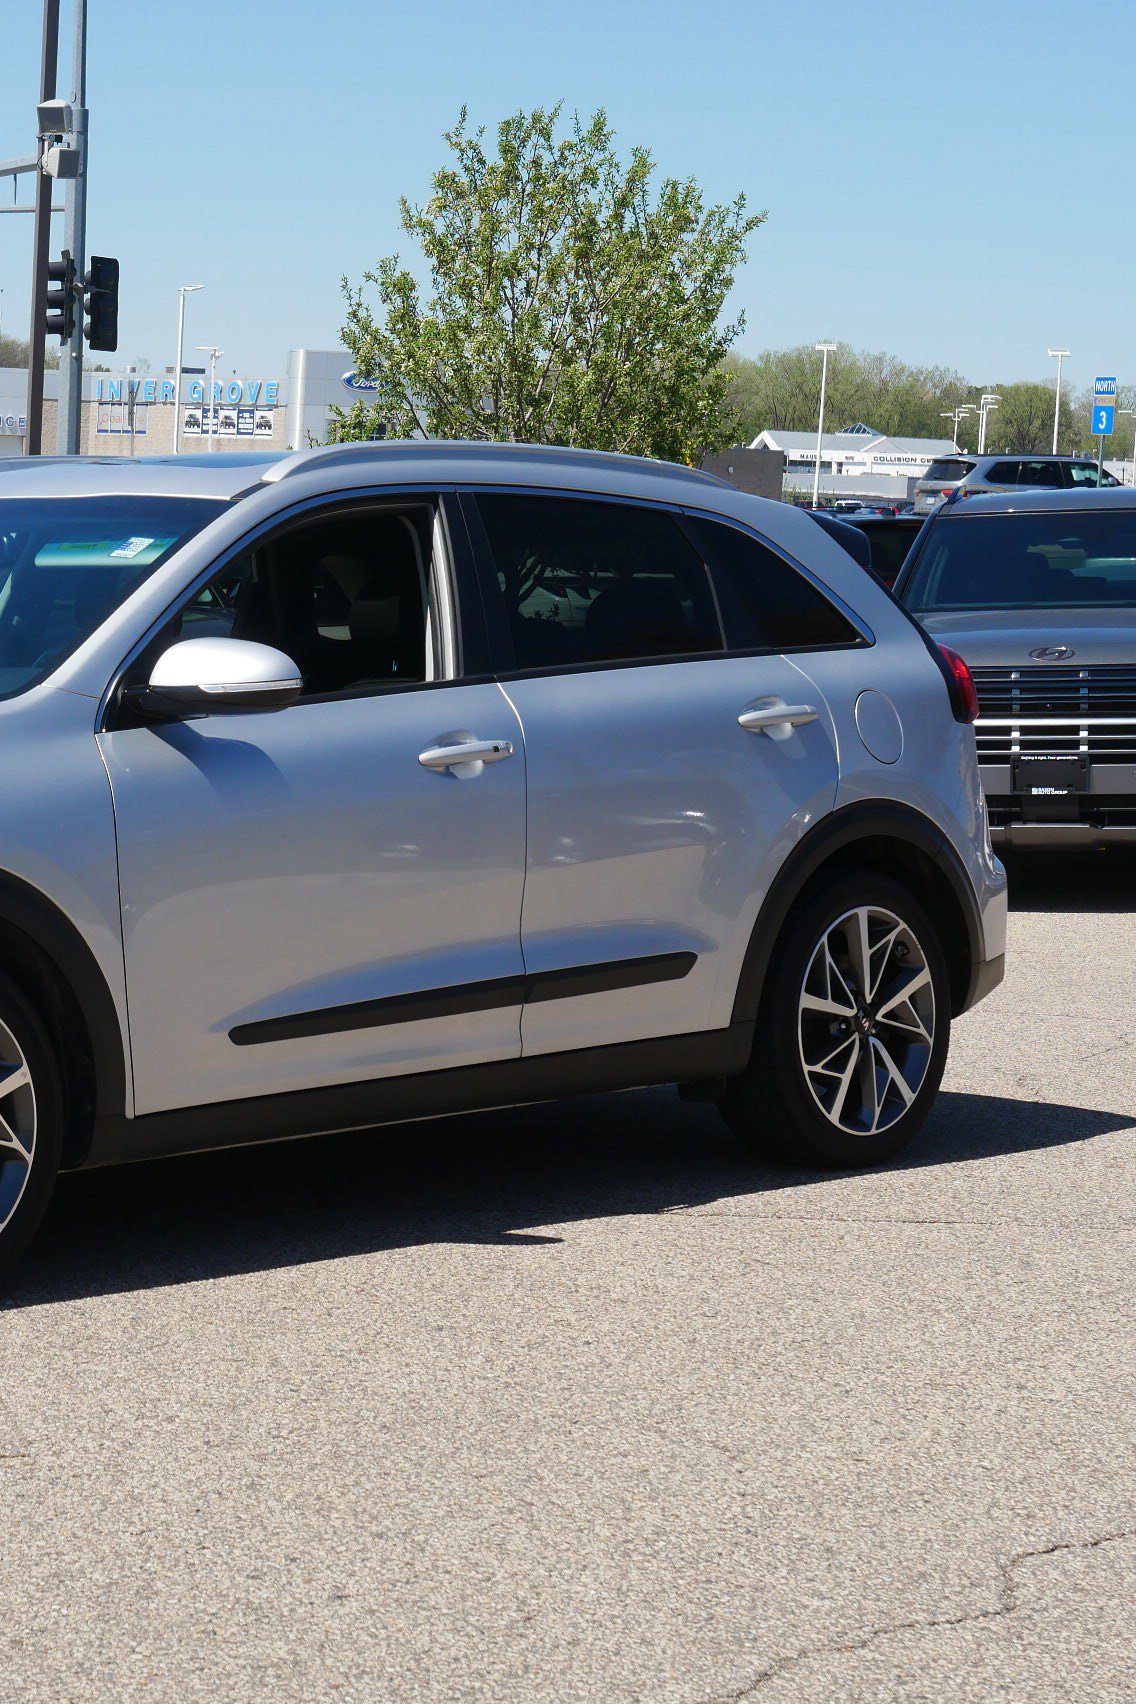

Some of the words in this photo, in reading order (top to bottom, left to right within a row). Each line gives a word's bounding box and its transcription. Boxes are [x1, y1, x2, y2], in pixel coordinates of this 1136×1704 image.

[96, 379, 175, 401] INVER
[189, 380, 279, 405] GROVE
[1095, 380, 1116, 392] NORTH
[1098, 411, 1107, 429] 3
[873, 455, 917, 463] COLLISION
